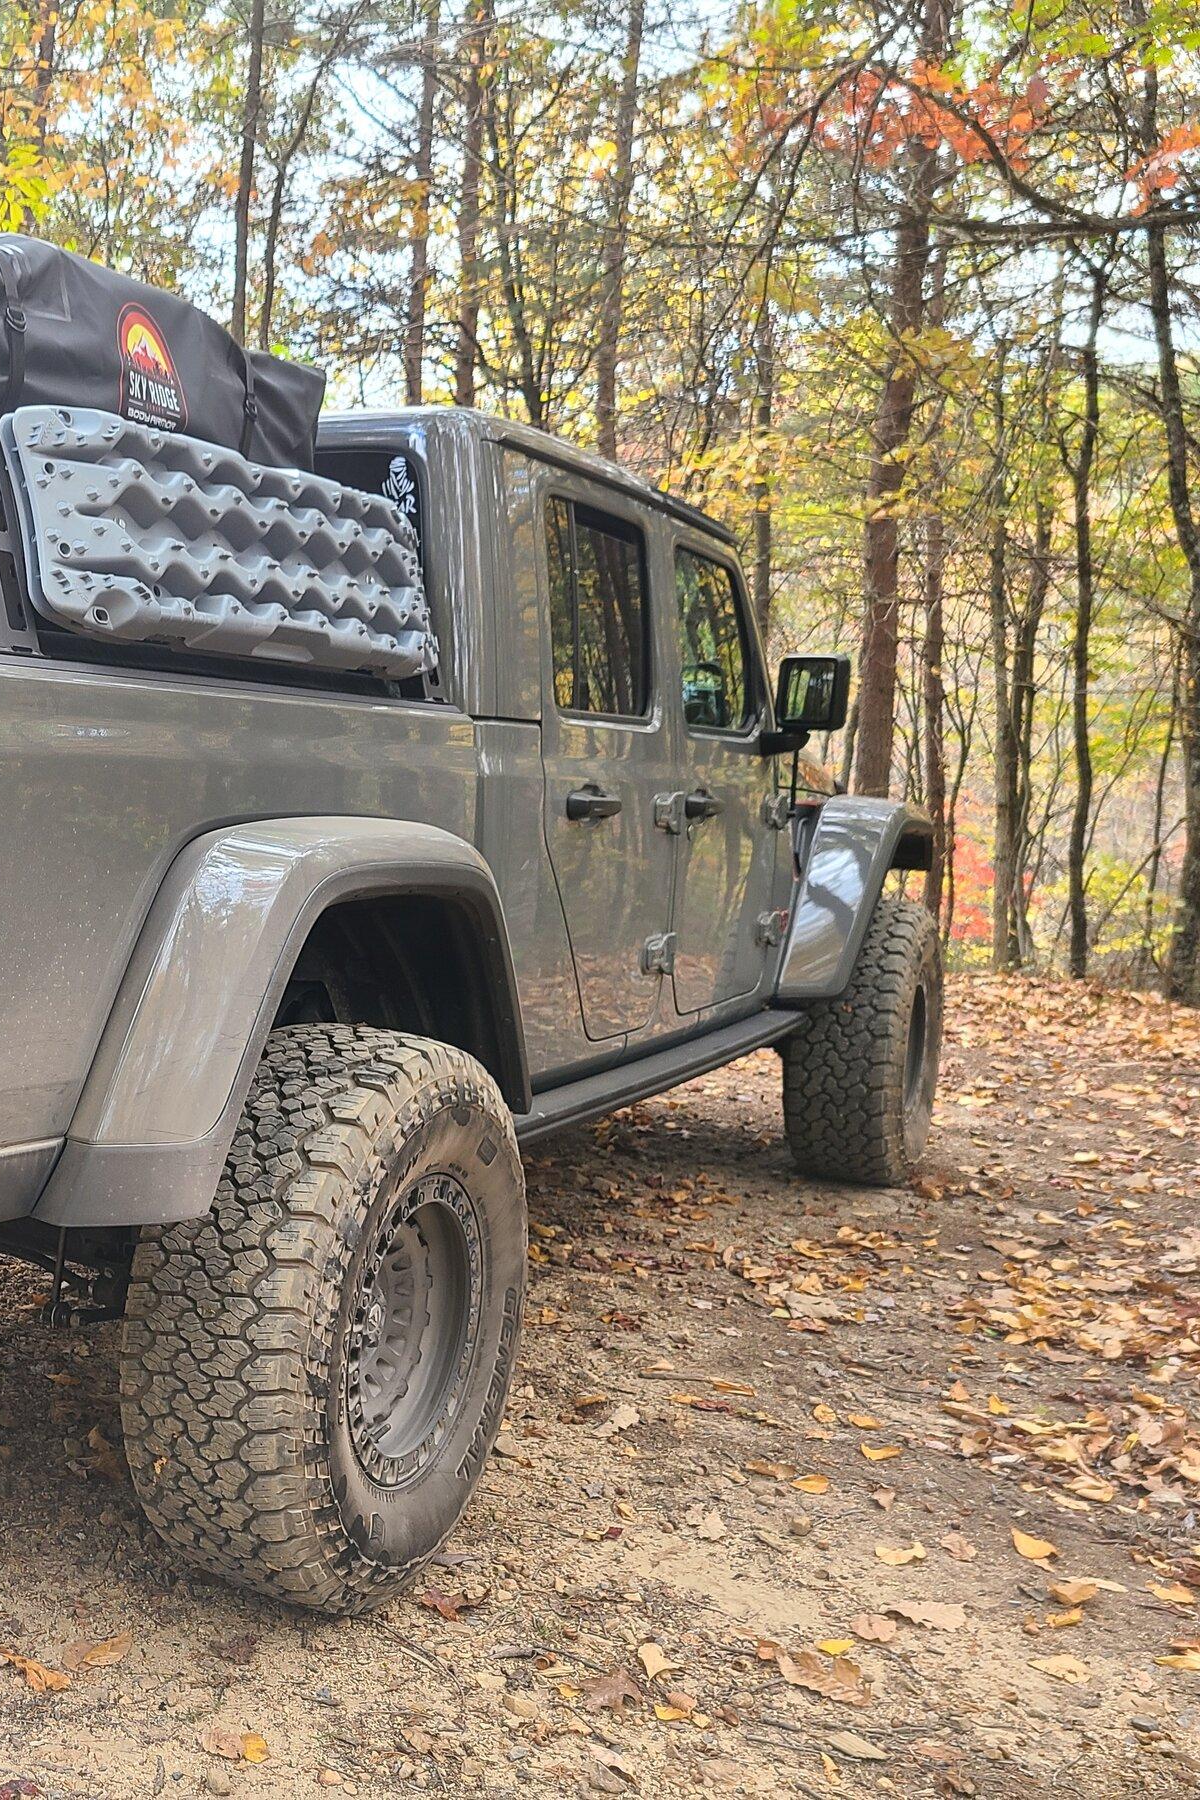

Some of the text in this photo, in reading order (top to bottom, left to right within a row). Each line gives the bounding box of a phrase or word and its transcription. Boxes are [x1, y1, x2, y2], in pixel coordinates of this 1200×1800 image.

[129, 370, 181, 412] SKY RIDGE
[127, 406, 151, 423] BODY
[149, 414, 177, 431] ARMOR
[454, 1286, 518, 1482] GENERAL
